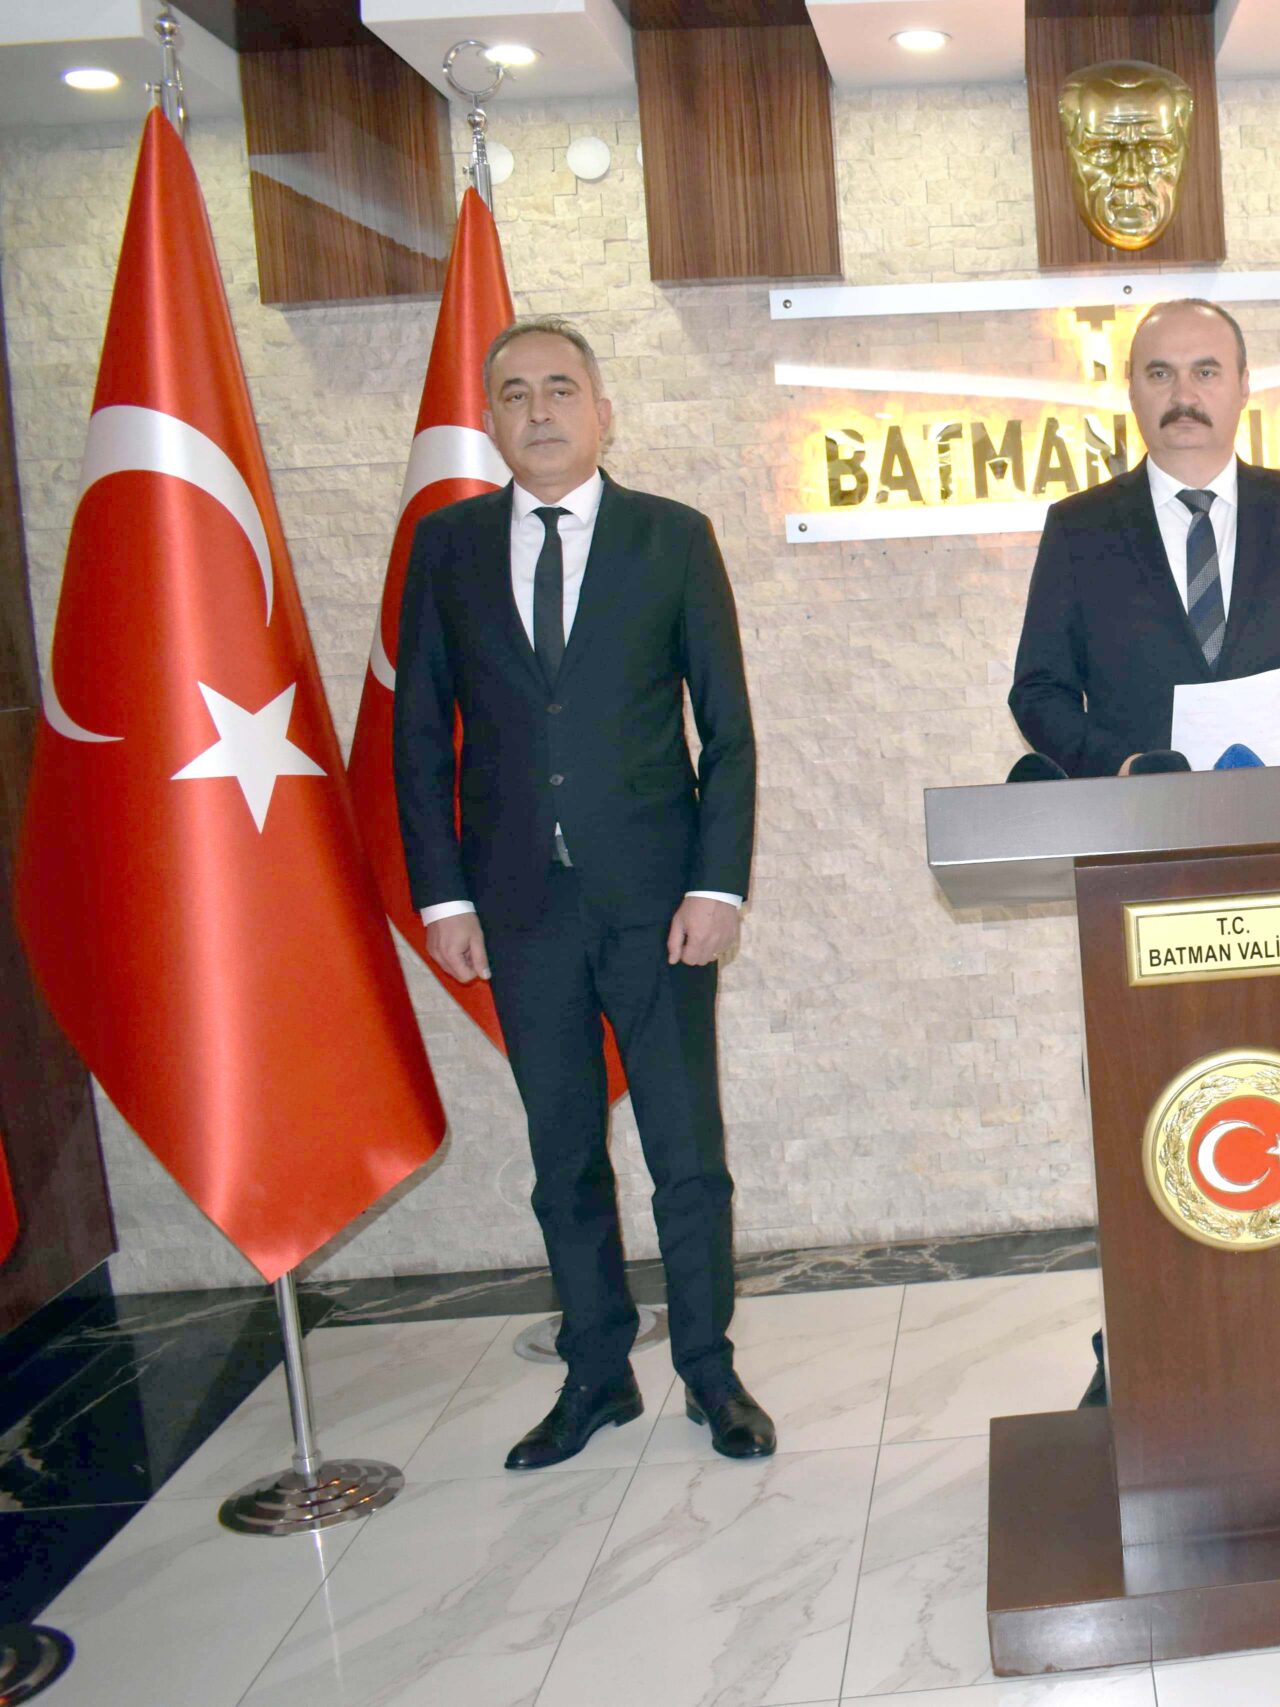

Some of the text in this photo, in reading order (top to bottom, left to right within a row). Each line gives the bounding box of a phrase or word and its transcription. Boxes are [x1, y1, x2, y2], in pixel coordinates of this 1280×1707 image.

[824, 414, 1129, 507] BATMAN
[1216, 916, 1250, 936] T.C.
[1149, 943, 1232, 967] BATMAN
